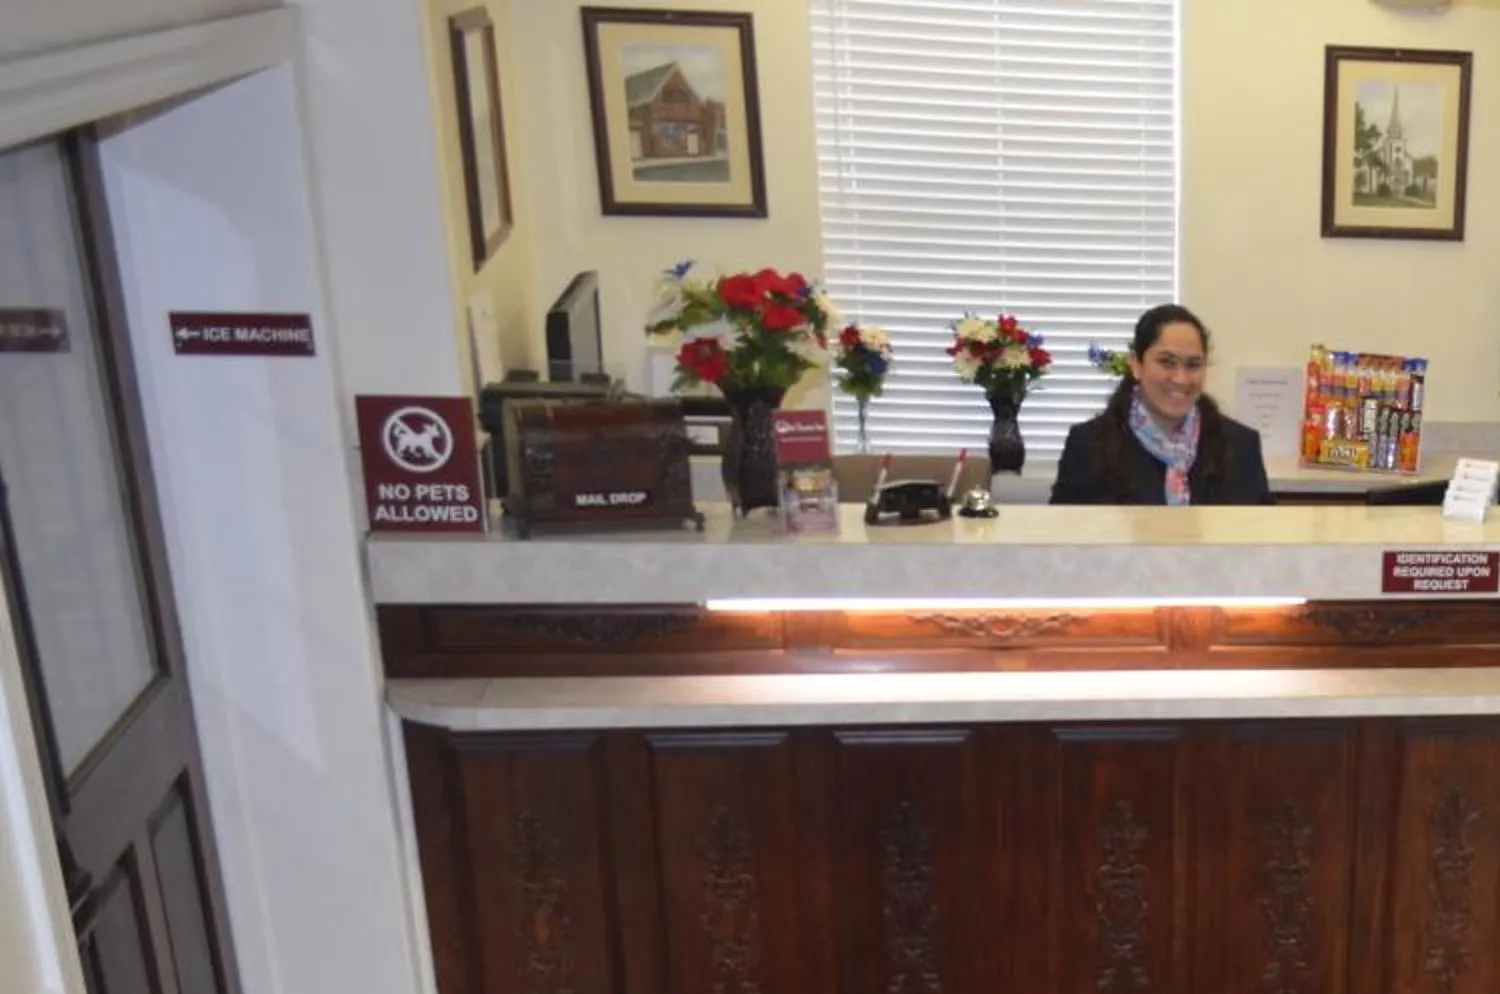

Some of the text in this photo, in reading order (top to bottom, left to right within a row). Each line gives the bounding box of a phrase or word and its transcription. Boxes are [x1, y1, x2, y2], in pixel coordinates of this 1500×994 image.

[203, 326, 310, 343] ICE MACHINE
[379, 483, 470, 502] NO PETS
[576, 491, 647, 506] MAIL DROP
[374, 504, 478, 522] ALLOWED
[1396, 553, 1489, 565] IDENTIFICATION
[1393, 566, 1491, 578] REQUIRED UPON
[1413, 579, 1470, 591] REQUEST
